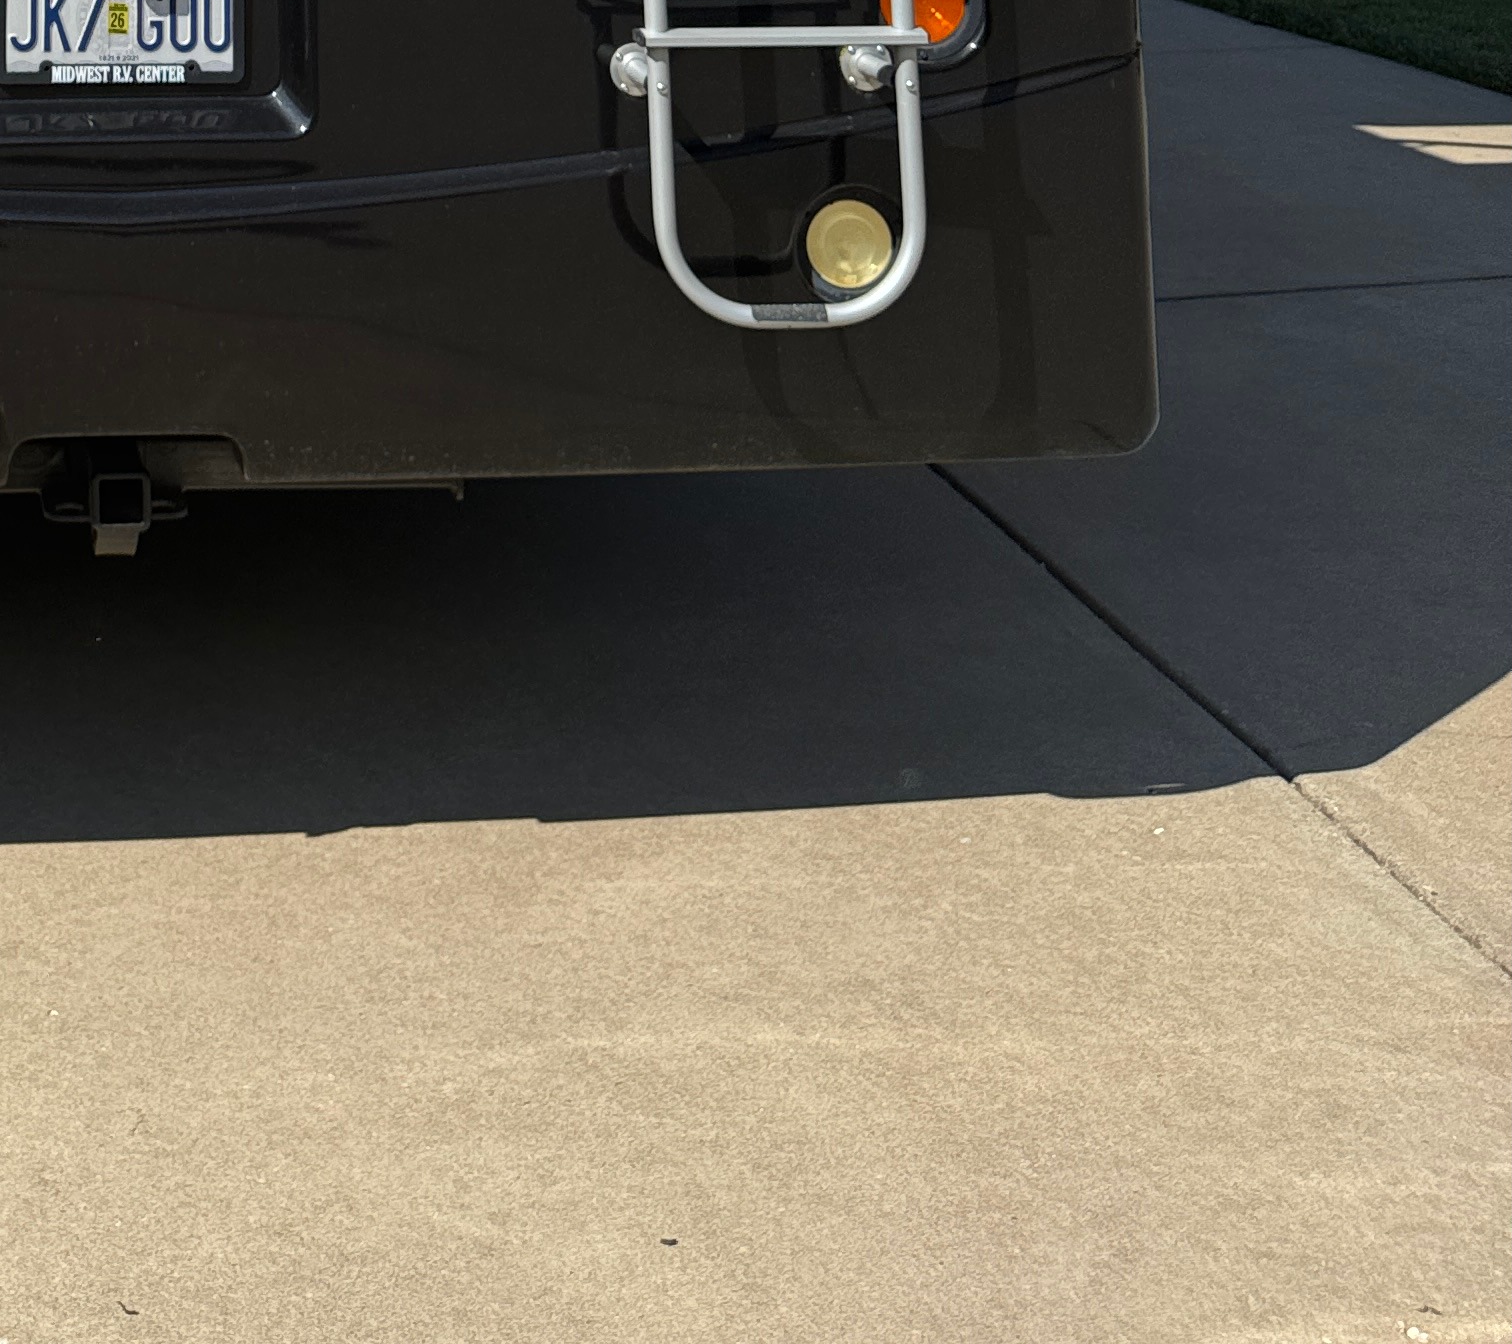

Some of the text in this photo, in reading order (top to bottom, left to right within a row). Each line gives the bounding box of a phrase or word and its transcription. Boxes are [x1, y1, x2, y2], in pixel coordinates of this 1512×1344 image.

[111, 13, 124, 28] 26
[51, 66, 185, 83] MIDWEST R.V. CENTER
